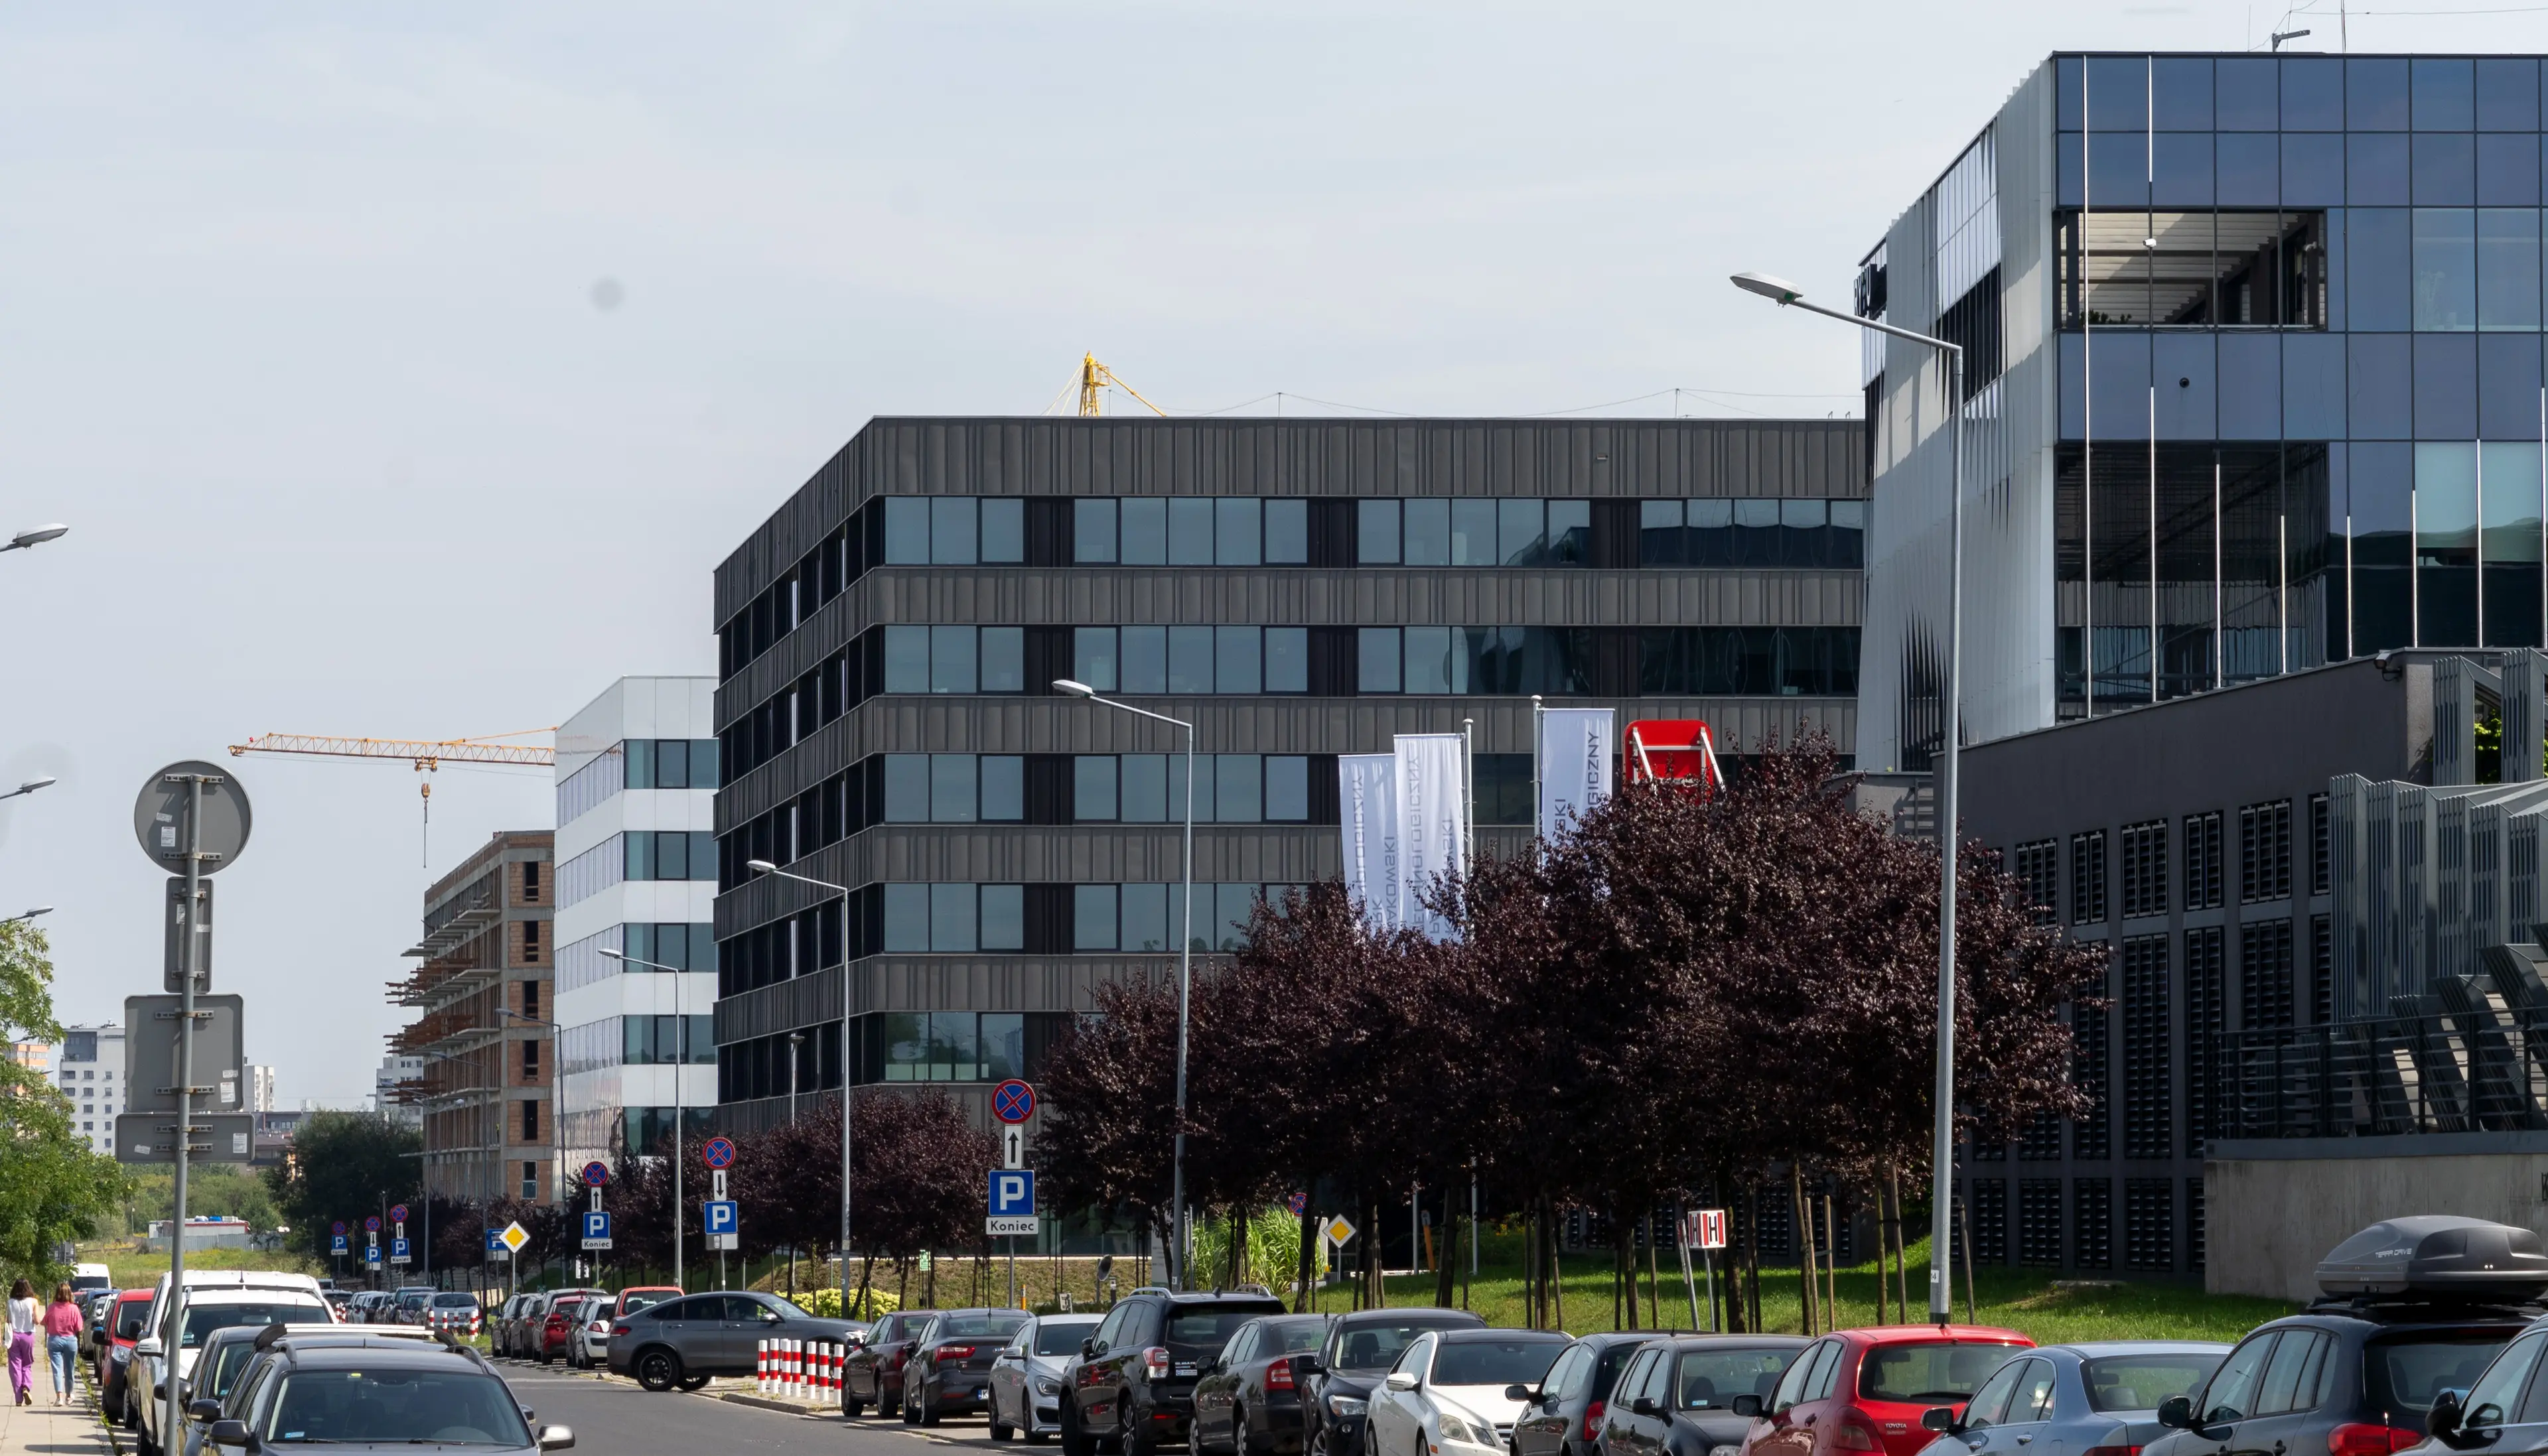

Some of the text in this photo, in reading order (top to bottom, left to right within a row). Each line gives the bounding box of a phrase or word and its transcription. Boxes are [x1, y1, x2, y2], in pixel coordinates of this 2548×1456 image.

[1000, 1176, 1025, 1210] P
[590, 1216, 604, 1235] P
[713, 1205, 730, 1230] P
[991, 1220, 1034, 1231] Koniec
[1693, 1216, 1698, 1242] H
[1709, 1216, 1717, 1242] H
[335, 1236, 344, 1247] P
[395, 1241, 405, 1254] P
[369, 1248, 378, 1260] P
